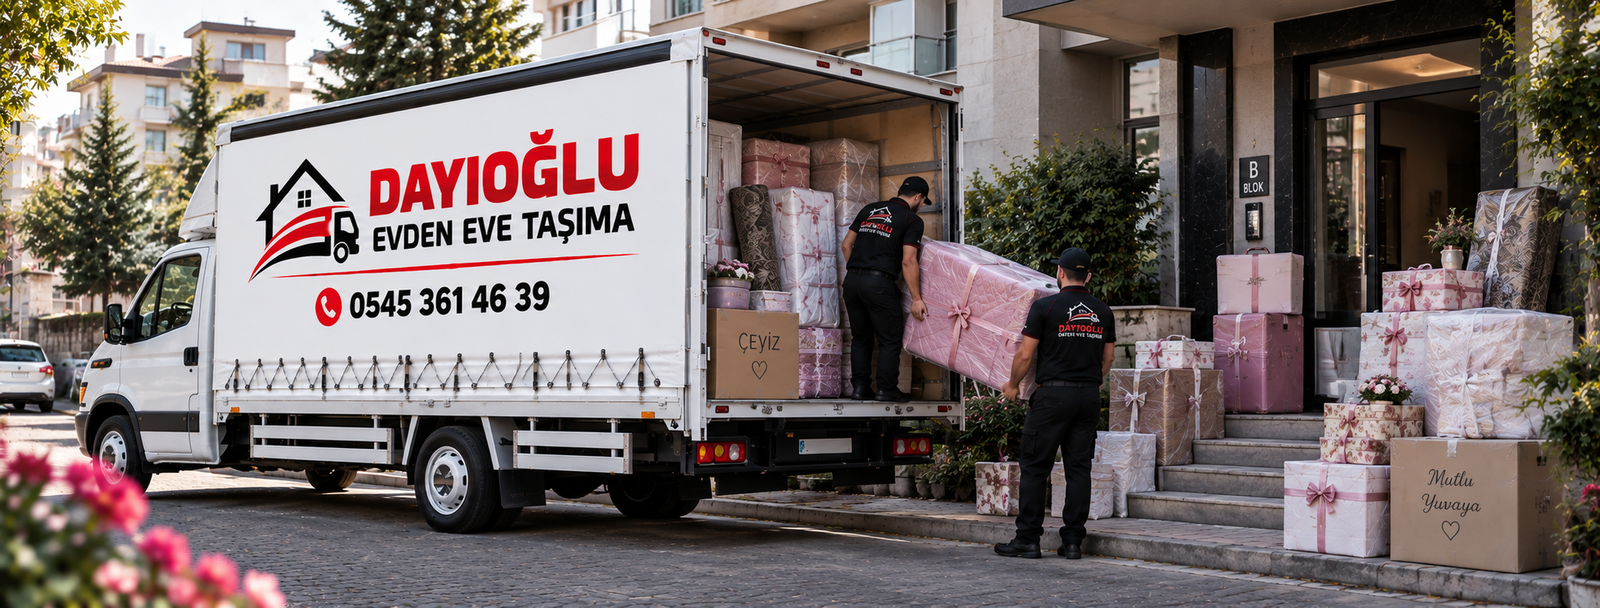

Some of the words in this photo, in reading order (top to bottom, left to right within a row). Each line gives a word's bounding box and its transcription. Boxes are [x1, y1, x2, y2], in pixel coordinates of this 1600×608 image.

[370, 128, 640, 217] DAYIOĞLU
[1249, 161, 1259, 179] B
[1243, 181, 1264, 194] BLOK
[372, 220, 453, 252] EVDEN
[462, 214, 512, 245] EVE
[521, 203, 635, 245] TAŞIMA
[349, 289, 412, 319] 0545
[418, 286, 463, 317] 361
[471, 283, 507, 314] 46
[514, 280, 550, 312] 39
[1427, 468, 1475, 488] Mutlu
[1421, 493, 1482, 518] Yuvaya
